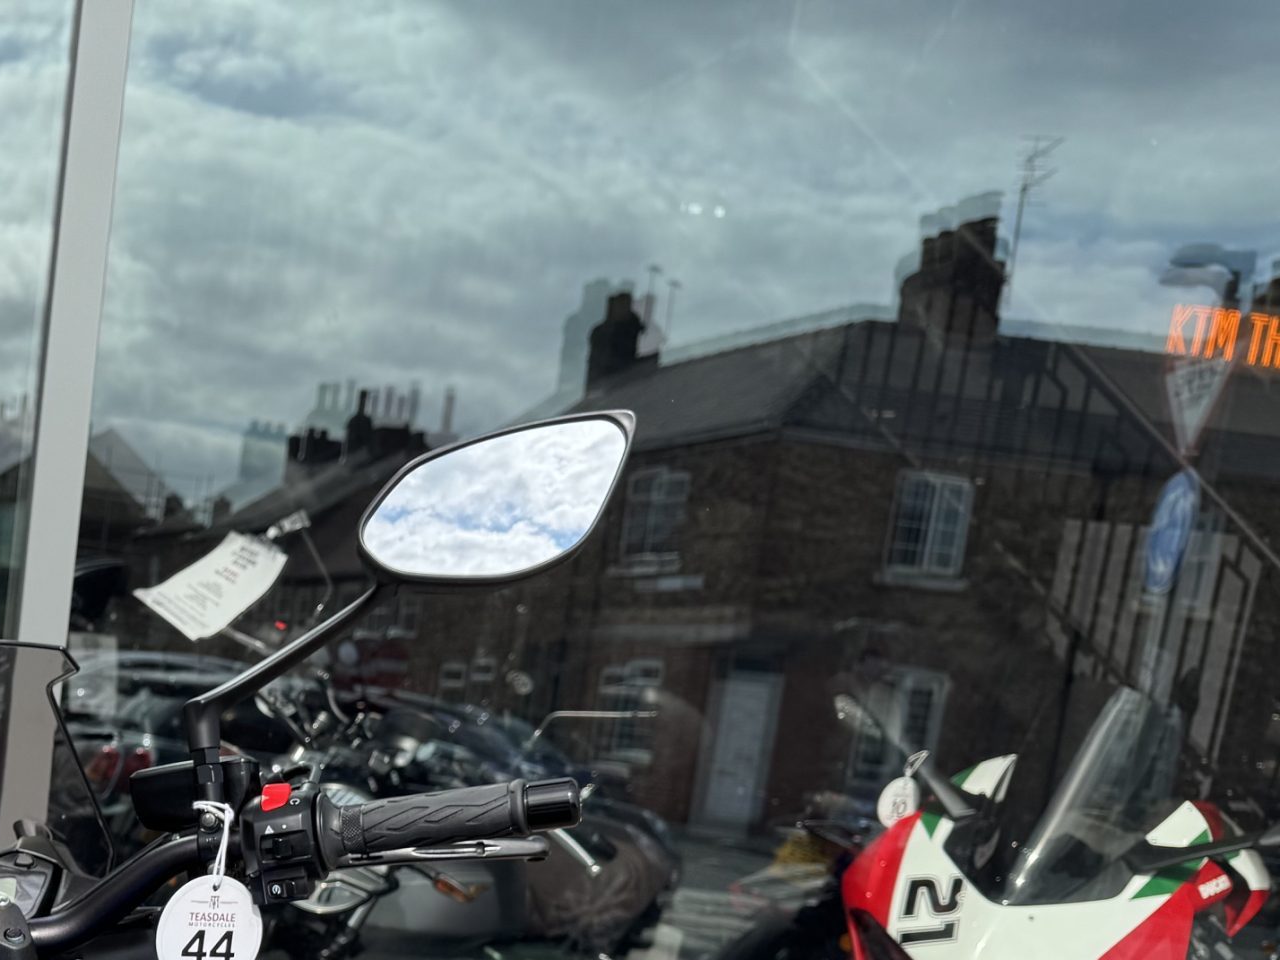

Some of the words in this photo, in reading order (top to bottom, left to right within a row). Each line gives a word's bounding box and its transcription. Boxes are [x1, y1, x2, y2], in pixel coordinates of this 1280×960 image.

[1165, 304, 1241, 362] KTM
[189, 912, 236, 922] TEASDALE
[898, 874, 966, 947] 21
